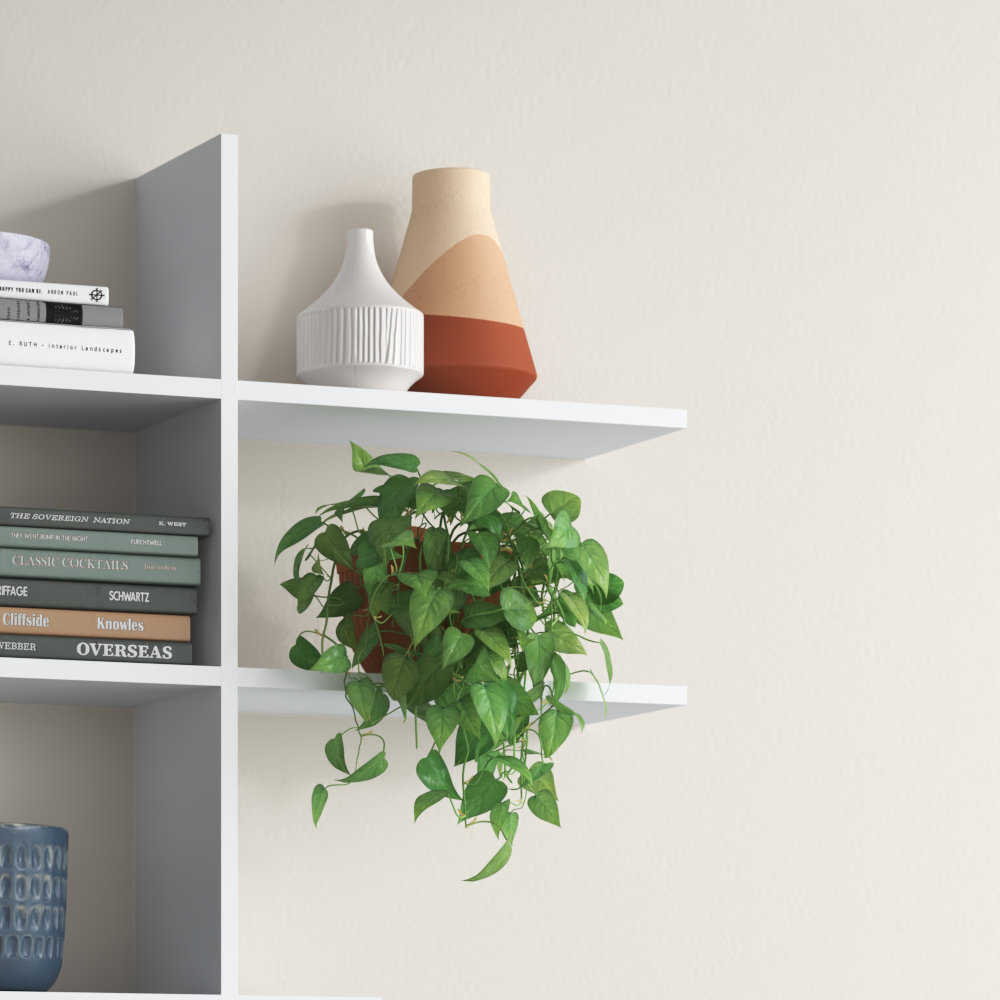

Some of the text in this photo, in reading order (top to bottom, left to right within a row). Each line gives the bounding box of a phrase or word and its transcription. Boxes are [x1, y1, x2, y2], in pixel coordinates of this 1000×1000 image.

[18, 340, 38, 348] RUTH
[48, 343, 77, 351] Interior
[81, 346, 122, 354] Landscapes
[10, 512, 131, 525] THE SOVEREIGN NATION
[11, 555, 59, 567] CLASSIC
[61, 557, 129, 570] COCKTAILS
[108, 590, 150, 603] SCHWARTZ
[2, 612, 50, 627] Cliffside
[97, 616, 144, 632] Knowles
[76, 641, 173, 660] OVERSEAS
